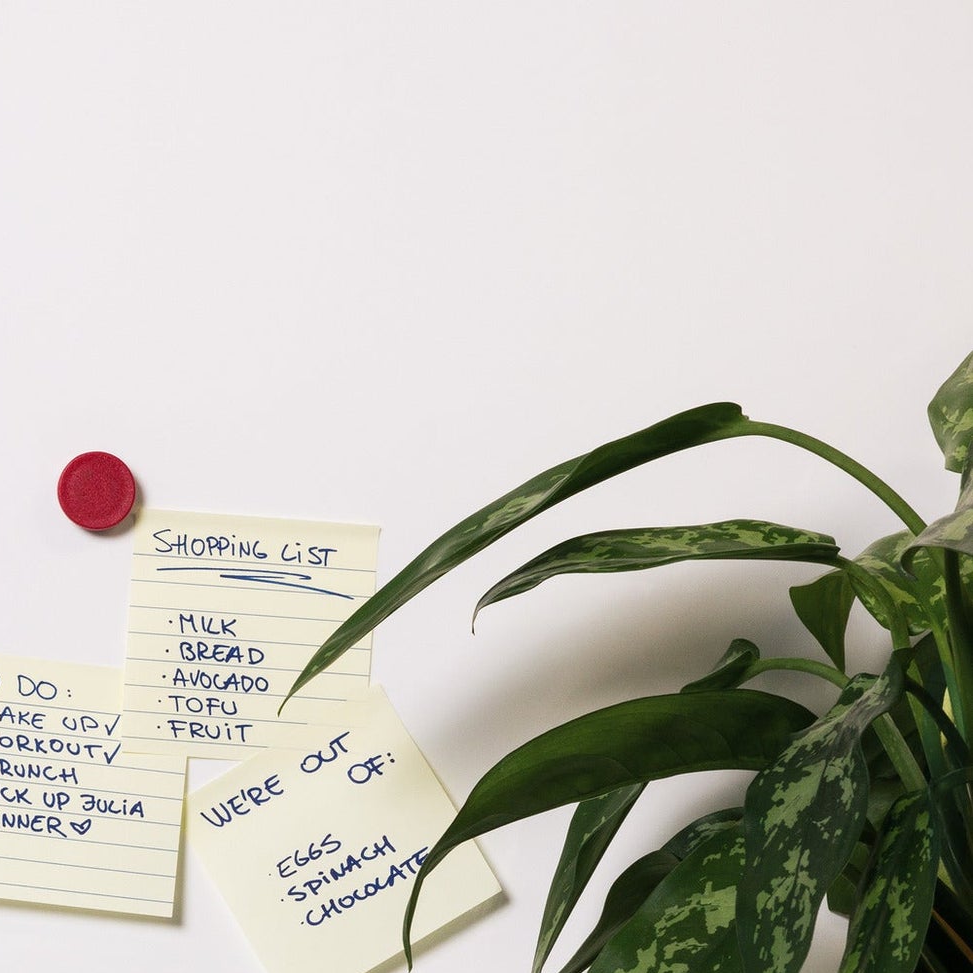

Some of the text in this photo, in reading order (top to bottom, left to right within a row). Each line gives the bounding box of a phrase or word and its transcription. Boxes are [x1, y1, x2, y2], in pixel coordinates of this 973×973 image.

[178, 613, 238, 638] MILK
[179, 641, 266, 666] BREAD
[172, 668, 270, 694] AVOCADO
[167, 694, 239, 717] TOFU
[62, 716, 100, 733] UP
[200, 731, 352, 829] WE'RE OUT
[44, 792, 72, 812] UP
[277, 833, 343, 879] EGGS
